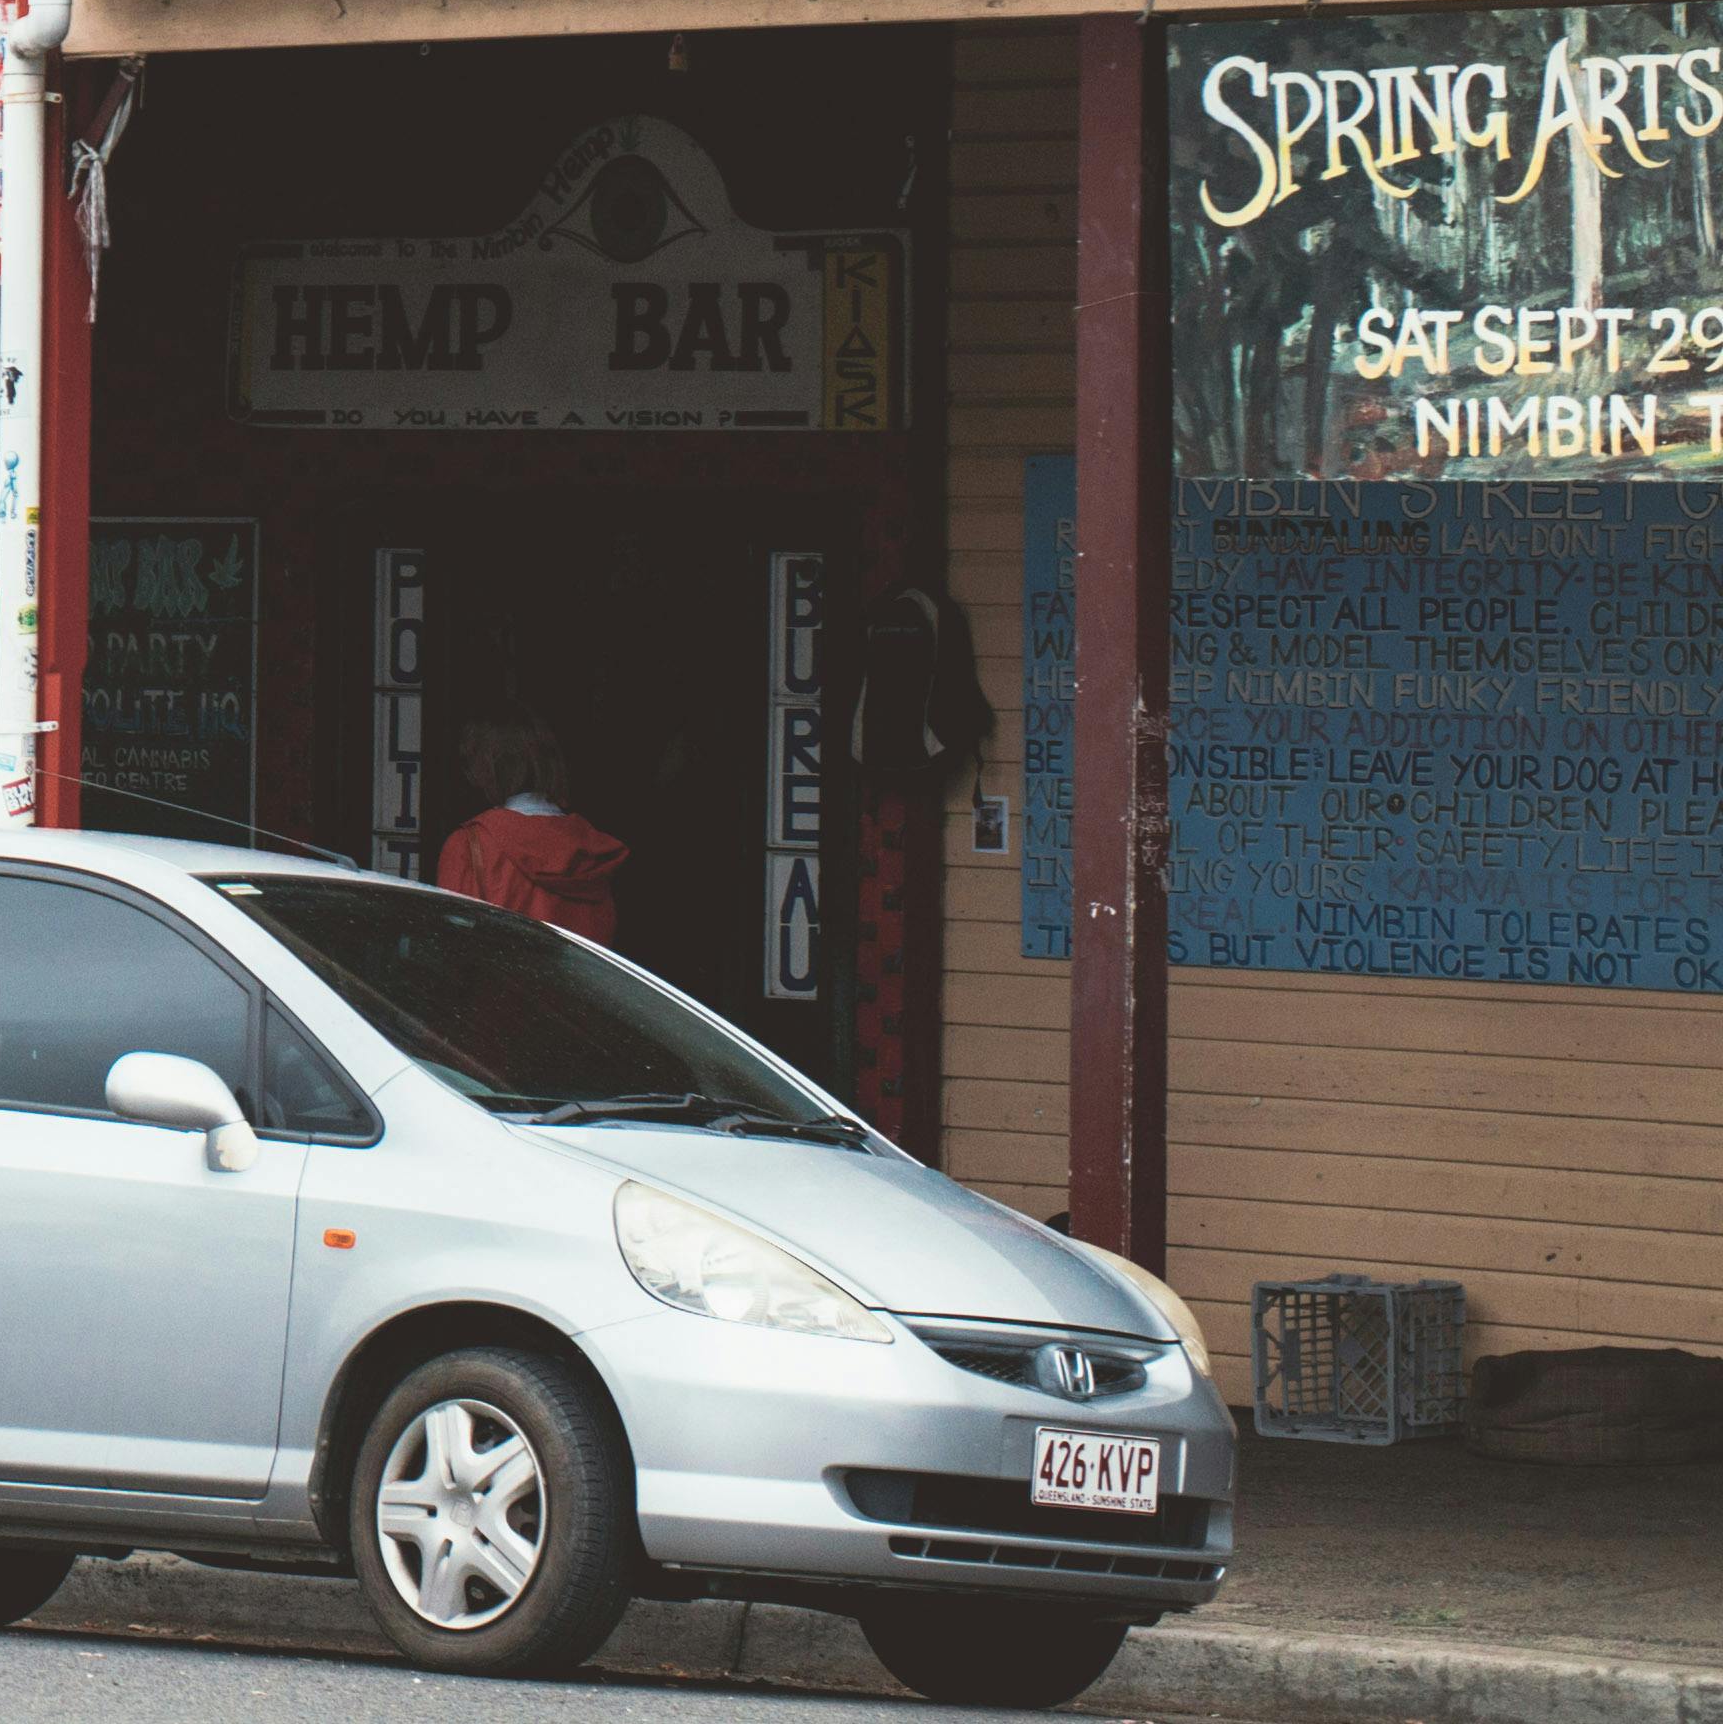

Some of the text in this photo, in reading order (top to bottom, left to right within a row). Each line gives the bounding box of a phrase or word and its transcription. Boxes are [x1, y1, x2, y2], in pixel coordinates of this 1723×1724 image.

[1200, 38, 1723, 227] SPRING ARTS
[270, 282, 514, 372] HEMP
[608, 281, 794, 373] BAR
[1354, 307, 1463, 380] SAT
[1473, 304, 1634, 376] SEPT
[332, 409, 363, 426] DO
[394, 409, 445, 426] YOU
[465, 409, 538, 427] HAVE
[560, 409, 585, 426] A
[605, 409, 703, 427] VISION
[1413, 393, 1657, 459] NIMBIN
[1176, 480, 1362, 518] MBIN
[1256, 557, 1345, 591] HAVE
[1332, 595, 1401, 631] ALL
[1270, 633, 1392, 670] MODEL
[1404, 634, 1653, 675] THEMSELVES
[1226, 673, 1375, 709] NIMBIN
[1245, 708, 1331, 745] YOUR
[1343, 709, 1546, 752] ADDICTION
[1562, 717, 1610, 753] ON
[113, 748, 211, 769] CANNABIS
[780, 558, 822, 993] BUREAU
[1024, 738, 1065, 775] BE
[1167, 742, 1310, 782] ONSIBLE
[1327, 747, 1435, 786] LEAVE
[1450, 751, 1543, 791] YOUR
[1552, 754, 1623, 795] DOG
[1631, 757, 1680, 796] AT
[1185, 783, 1296, 818] ABOUT
[1320, 788, 1386, 823] OUR
[1410, 791, 1613, 833] CHILDREN
[1217, 822, 1264, 855] OF
[1275, 822, 1398, 862] THEIR
[1388, 866, 1526, 907] KARMA
[1539, 874, 1592, 911] IS
[1613, 876, 1689, 914] FOR
[1295, 901, 1456, 942] NIMBIN
[1475, 908, 1712, 957] TOLERATES
[1209, 932, 1275, 966] BUT
[1295, 936, 1486, 978] VIOLENCE
[1499, 946, 1551, 982] IS
[1568, 951, 1642, 986] NOT
[1037, 1489, 1154, 1511] QUEENSLAND SUNSHINE STATE
